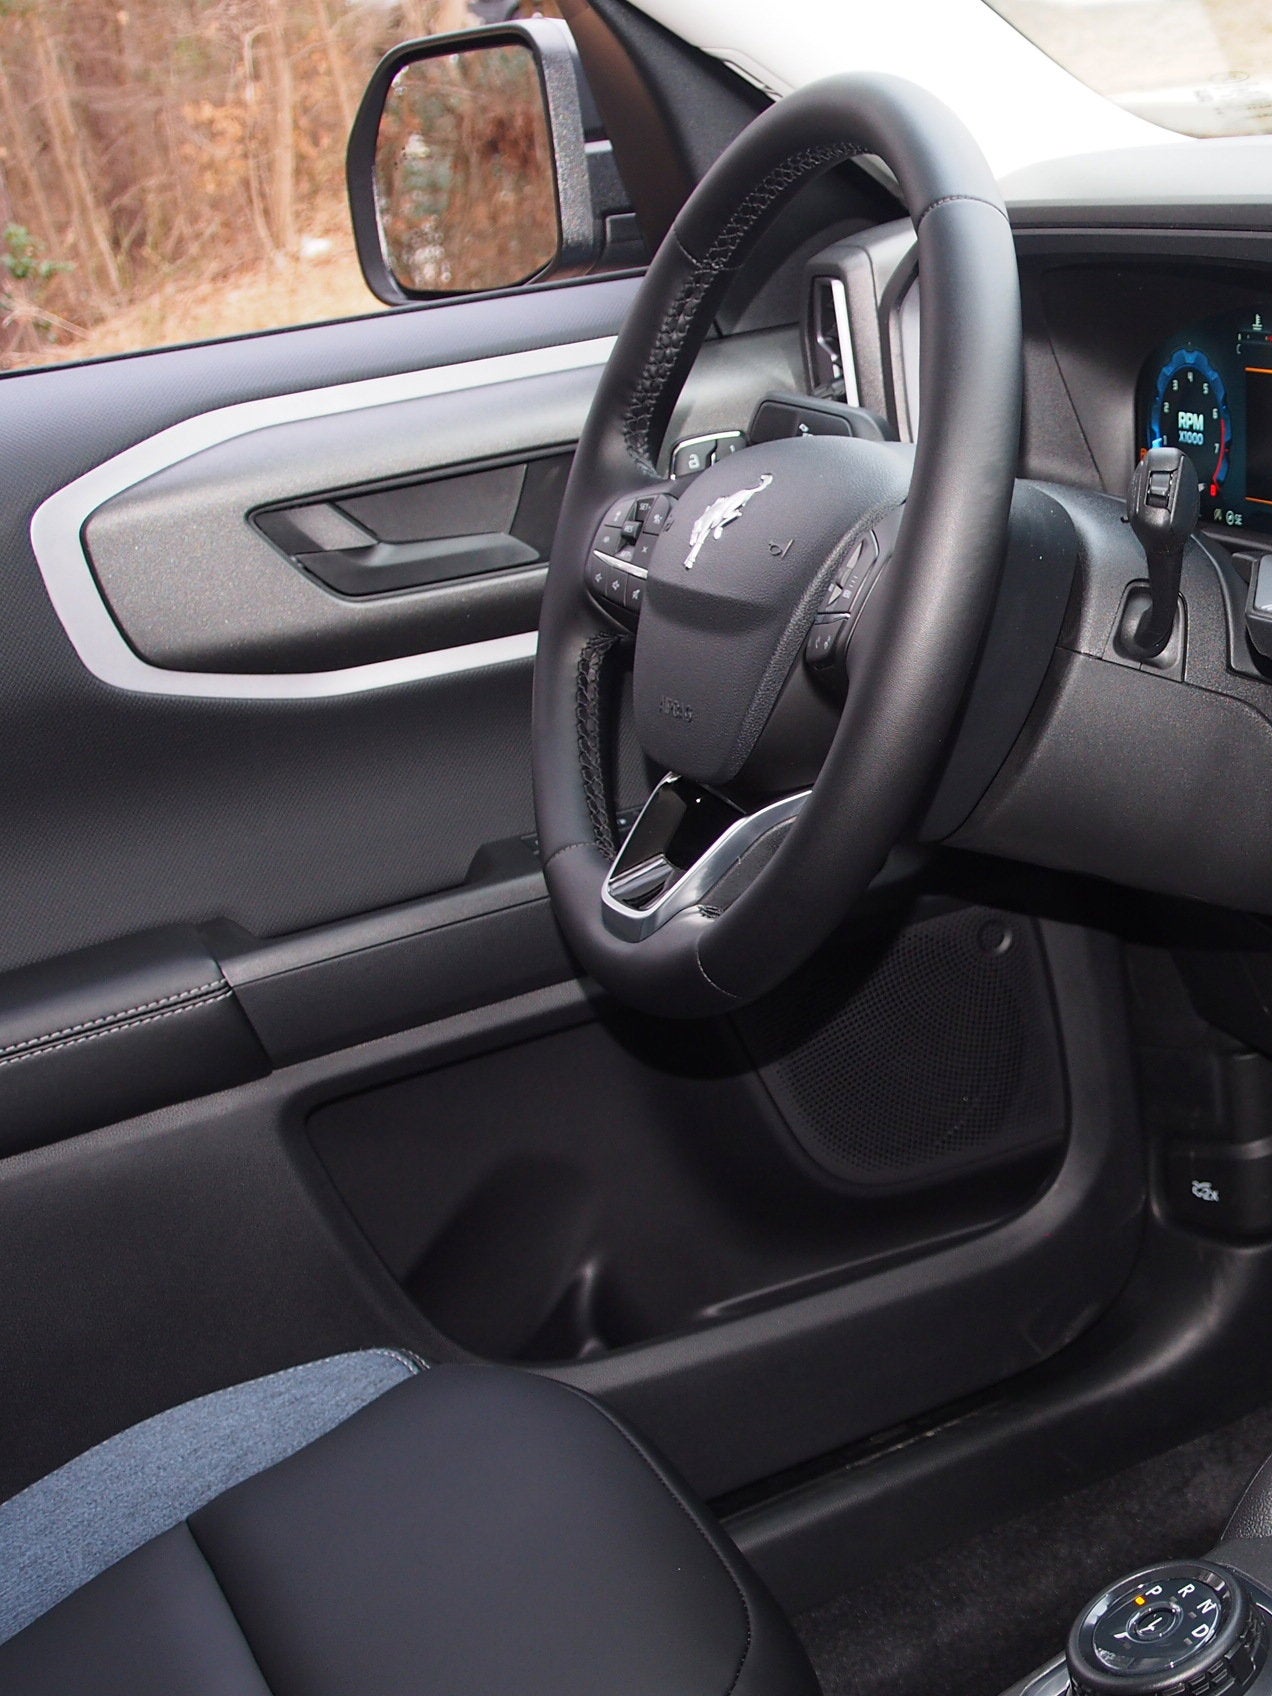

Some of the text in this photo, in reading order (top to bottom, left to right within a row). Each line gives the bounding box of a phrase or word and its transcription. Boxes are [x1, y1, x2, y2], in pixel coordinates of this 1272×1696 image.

[1172, 379, 1178, 391] 3
[1163, 402, 1169, 413] 2
[1178, 411, 1204, 431] RPM
[1145, 1585, 1163, 1596] P
[1178, 1583, 1195, 1598] R
[1197, 1599, 1216, 1614] N
[1191, 1623, 1210, 1638] D
